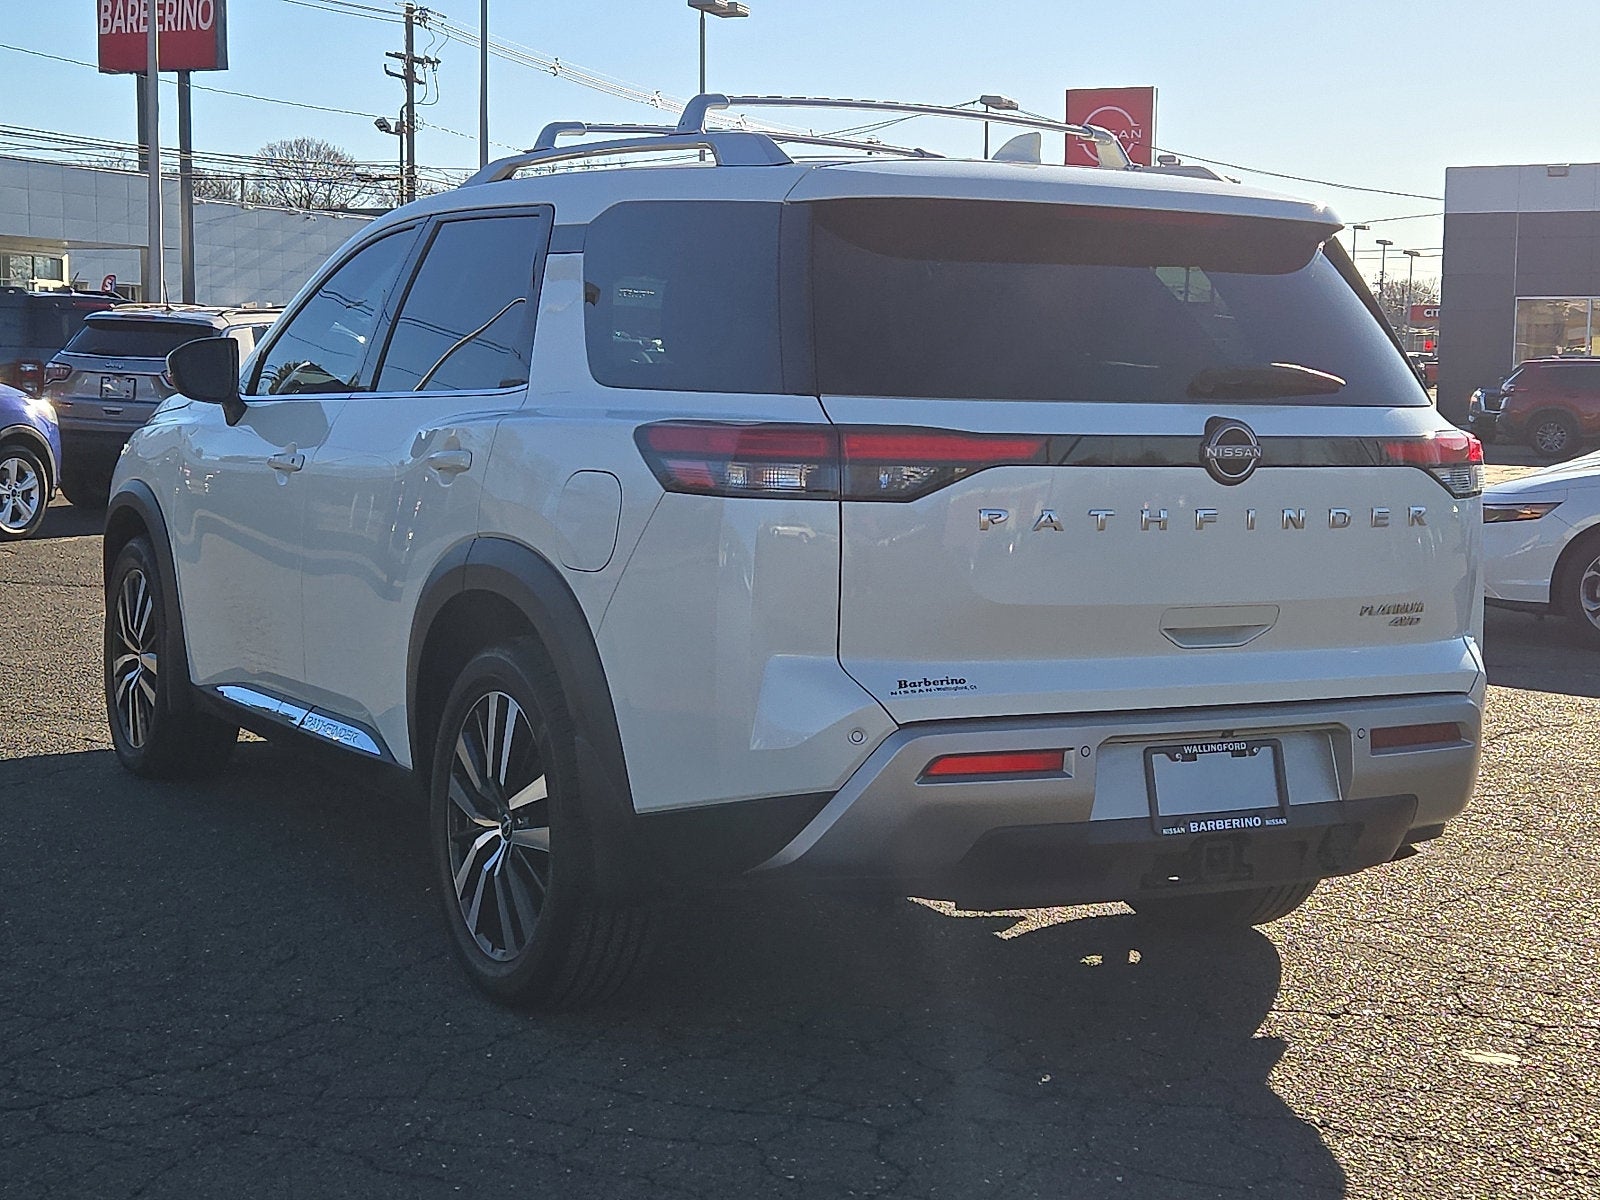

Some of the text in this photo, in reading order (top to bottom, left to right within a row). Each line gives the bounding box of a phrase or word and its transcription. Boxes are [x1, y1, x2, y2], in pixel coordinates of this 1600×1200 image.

[1206, 447, 1261, 457] NISSAN
[978, 505, 1428, 532] PATHFINDER
[897, 676, 966, 689] Barberino
[890, 688, 932, 696] NISSAN
[1184, 742, 1247, 754] WALLINGFORD
[1162, 816, 1287, 835] NISSAN BARBERINO NISSAN
